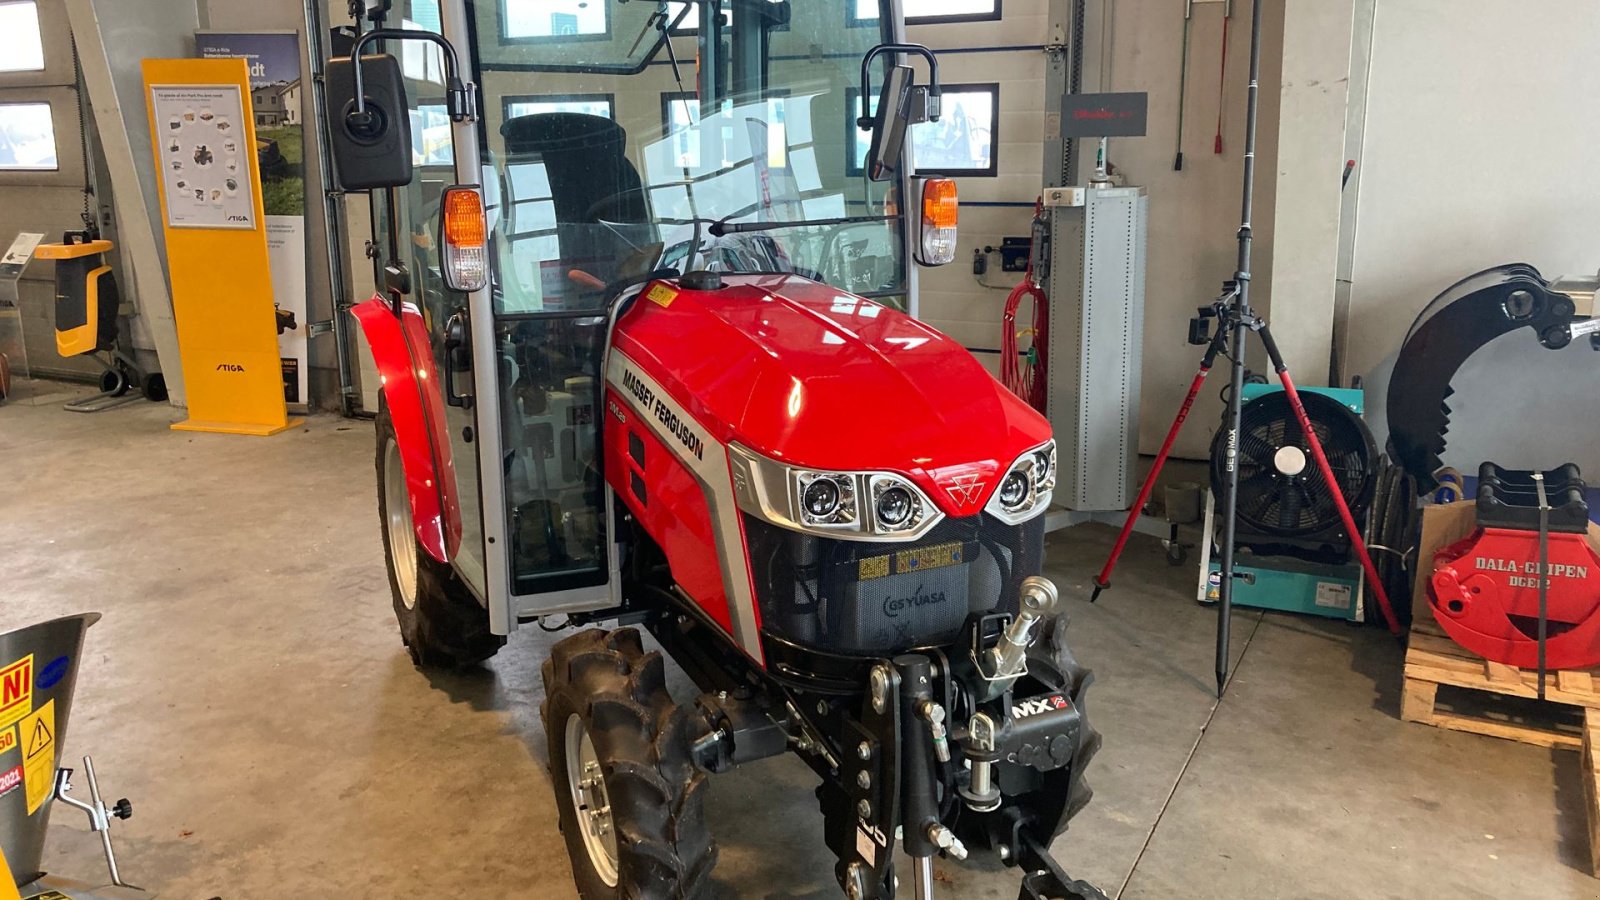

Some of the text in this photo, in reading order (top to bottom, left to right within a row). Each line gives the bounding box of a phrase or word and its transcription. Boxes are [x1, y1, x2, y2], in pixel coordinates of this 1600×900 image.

[216, 364, 245, 372] STIGA
[622, 368, 704, 461] MASSEY FERGUSON
[1012, 698, 1055, 719] MX
[0, 768, 21, 790] 2021
